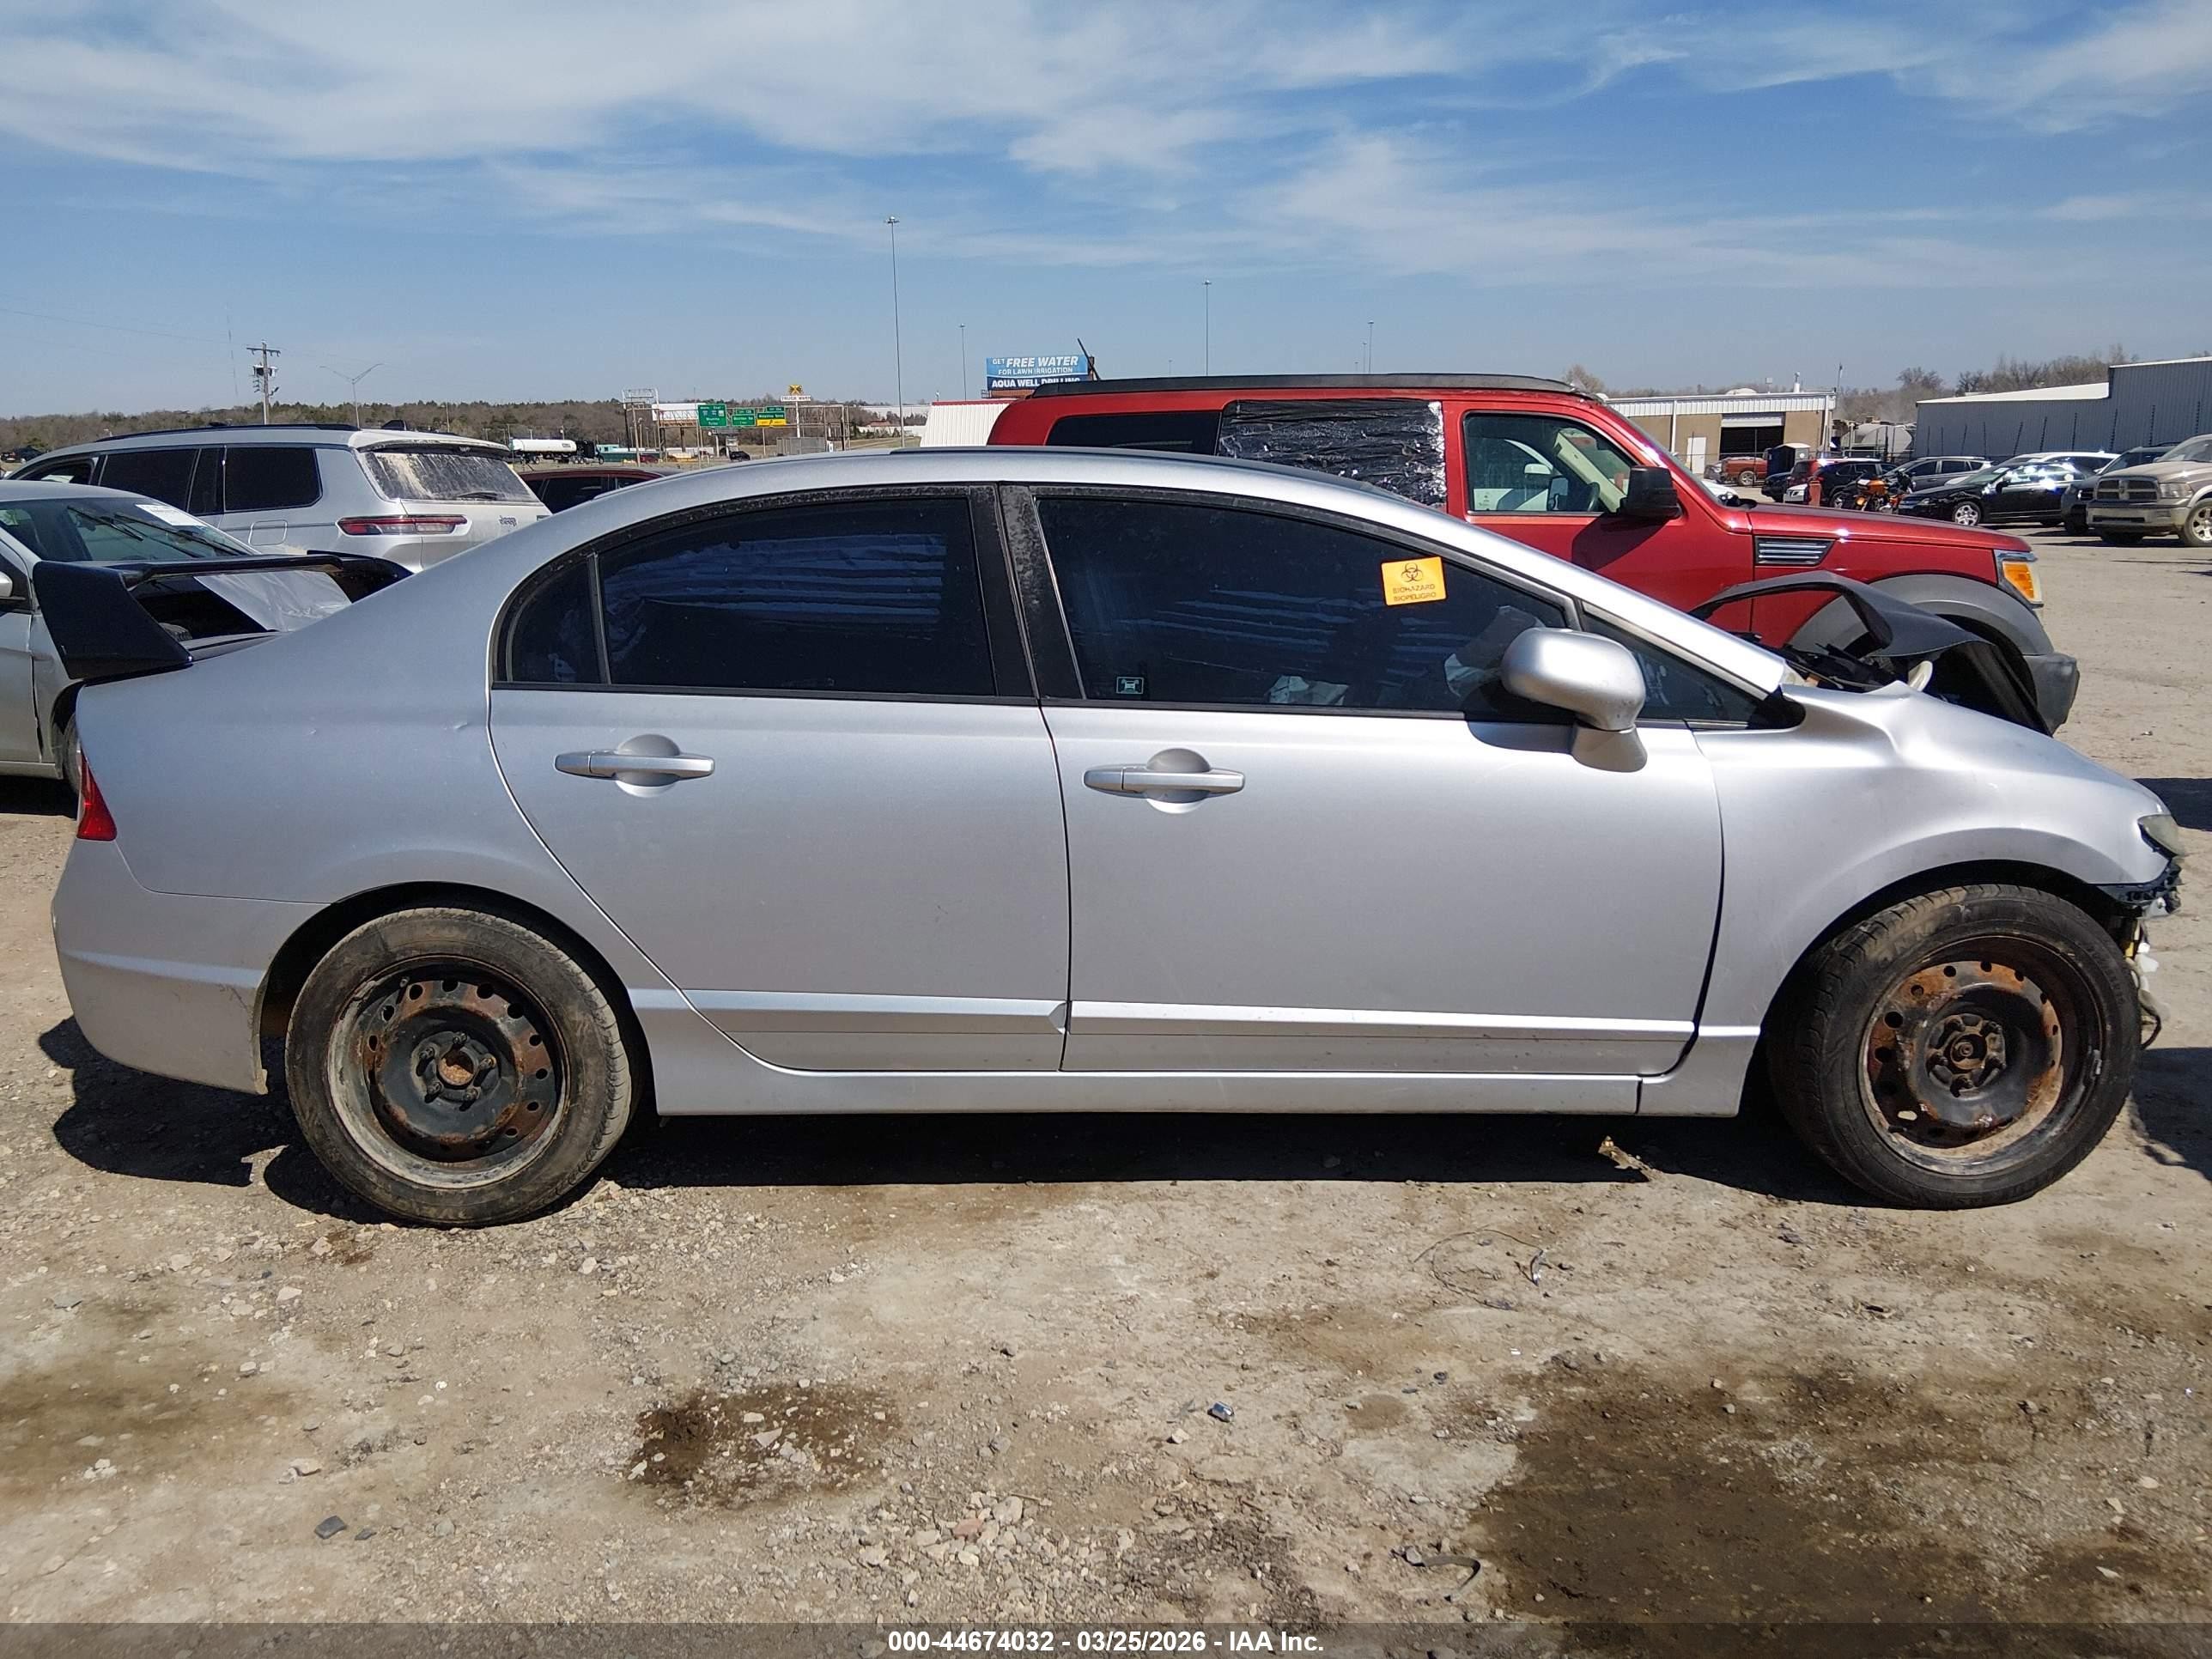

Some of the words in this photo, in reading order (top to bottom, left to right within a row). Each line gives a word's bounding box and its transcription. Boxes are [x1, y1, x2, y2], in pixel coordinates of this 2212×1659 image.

[1006, 357, 1035, 368] FREE
[1038, 356, 1079, 367] WATER
[992, 380, 1016, 388] AQUA
[1017, 379, 1040, 387] WELL
[1393, 584, 1436, 594] BIOHAZARD
[1394, 592, 1437, 602] BIOPELIGRO
